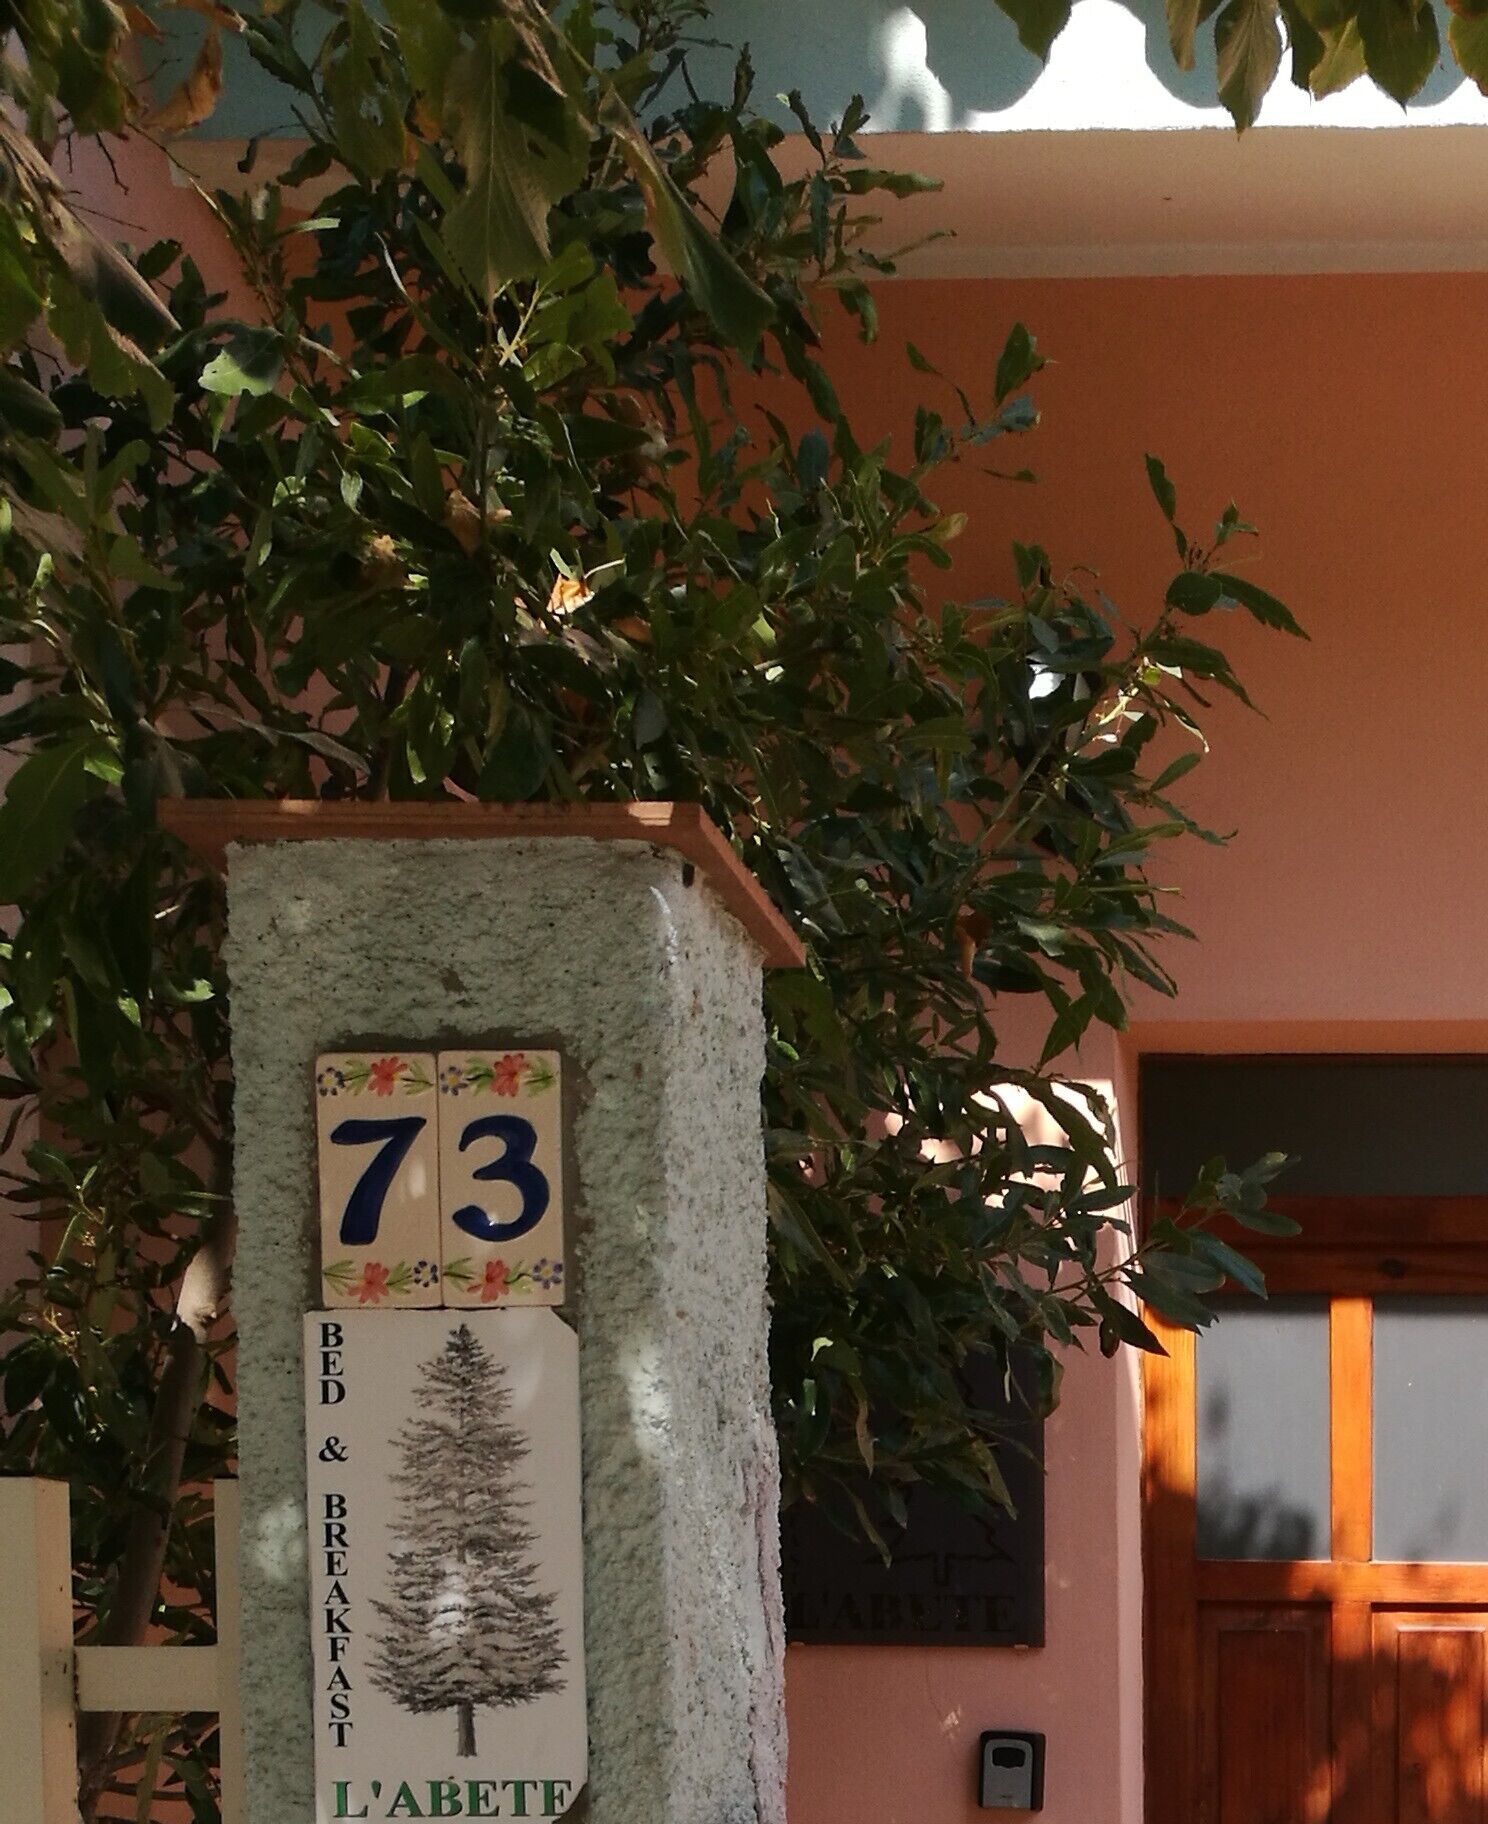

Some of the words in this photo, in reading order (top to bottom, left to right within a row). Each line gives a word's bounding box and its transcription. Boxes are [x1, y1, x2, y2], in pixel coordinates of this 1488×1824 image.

[330, 1114, 550, 1246] 73
[318, 1321, 347, 1406] BED
[318, 1435, 350, 1463] &
[322, 1492, 354, 1748] BREAKFAST
[331, 1779, 573, 1819] L'ABETE
